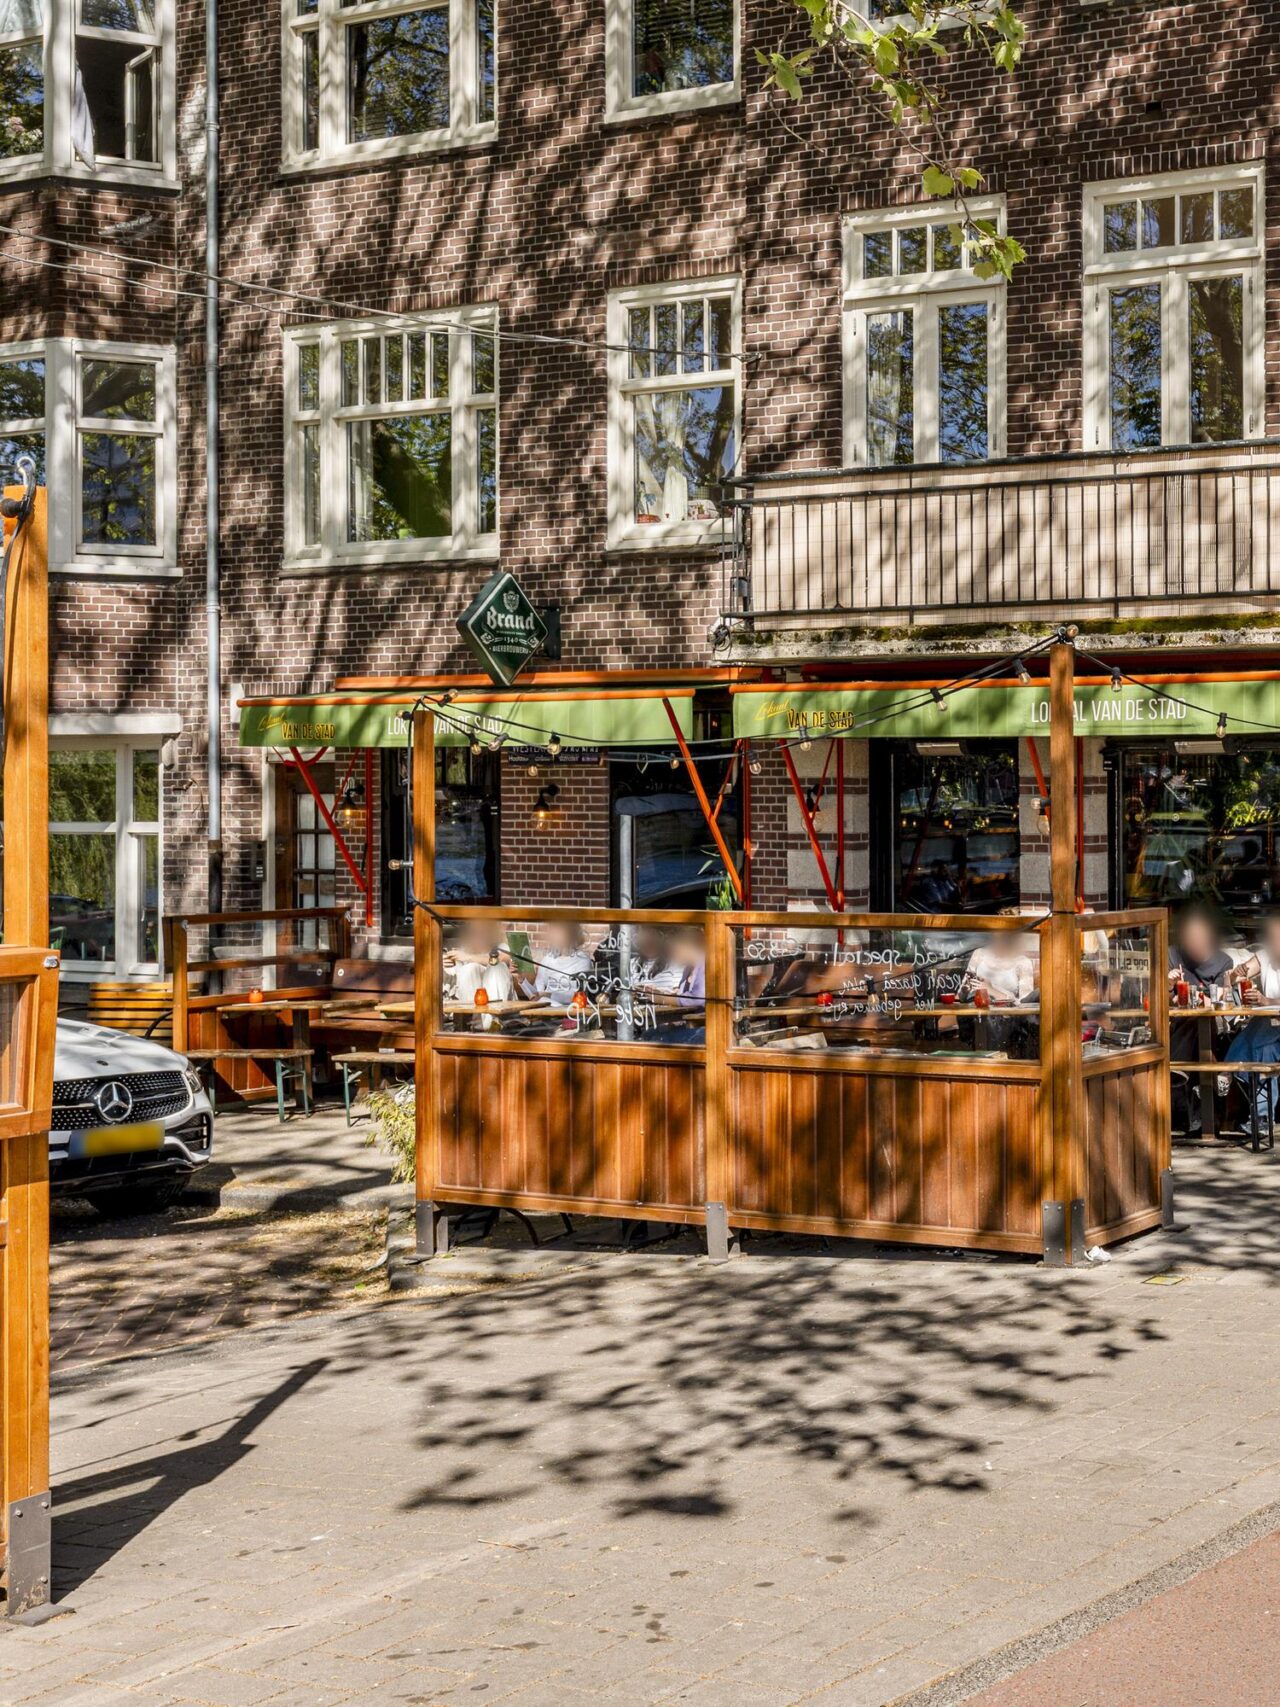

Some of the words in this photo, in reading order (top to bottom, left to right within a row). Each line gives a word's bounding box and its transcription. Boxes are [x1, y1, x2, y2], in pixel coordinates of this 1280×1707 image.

[487, 606, 535, 630] Brand
[788, 708, 808, 728] VAN
[812, 711, 825, 728] DE
[829, 711, 855, 728] STAD
[1031, 701, 1087, 723] LOAL
[1092, 700, 1121, 721] VAN
[1125, 699, 1145, 720] DE
[1148, 697, 1187, 720] STAD
[282, 721, 299, 739] VAN
[302, 723, 313, 739] DE
[315, 722, 336, 739] STAD
[434, 717, 453, 734] VAN
[474, 715, 503, 734] STAD
